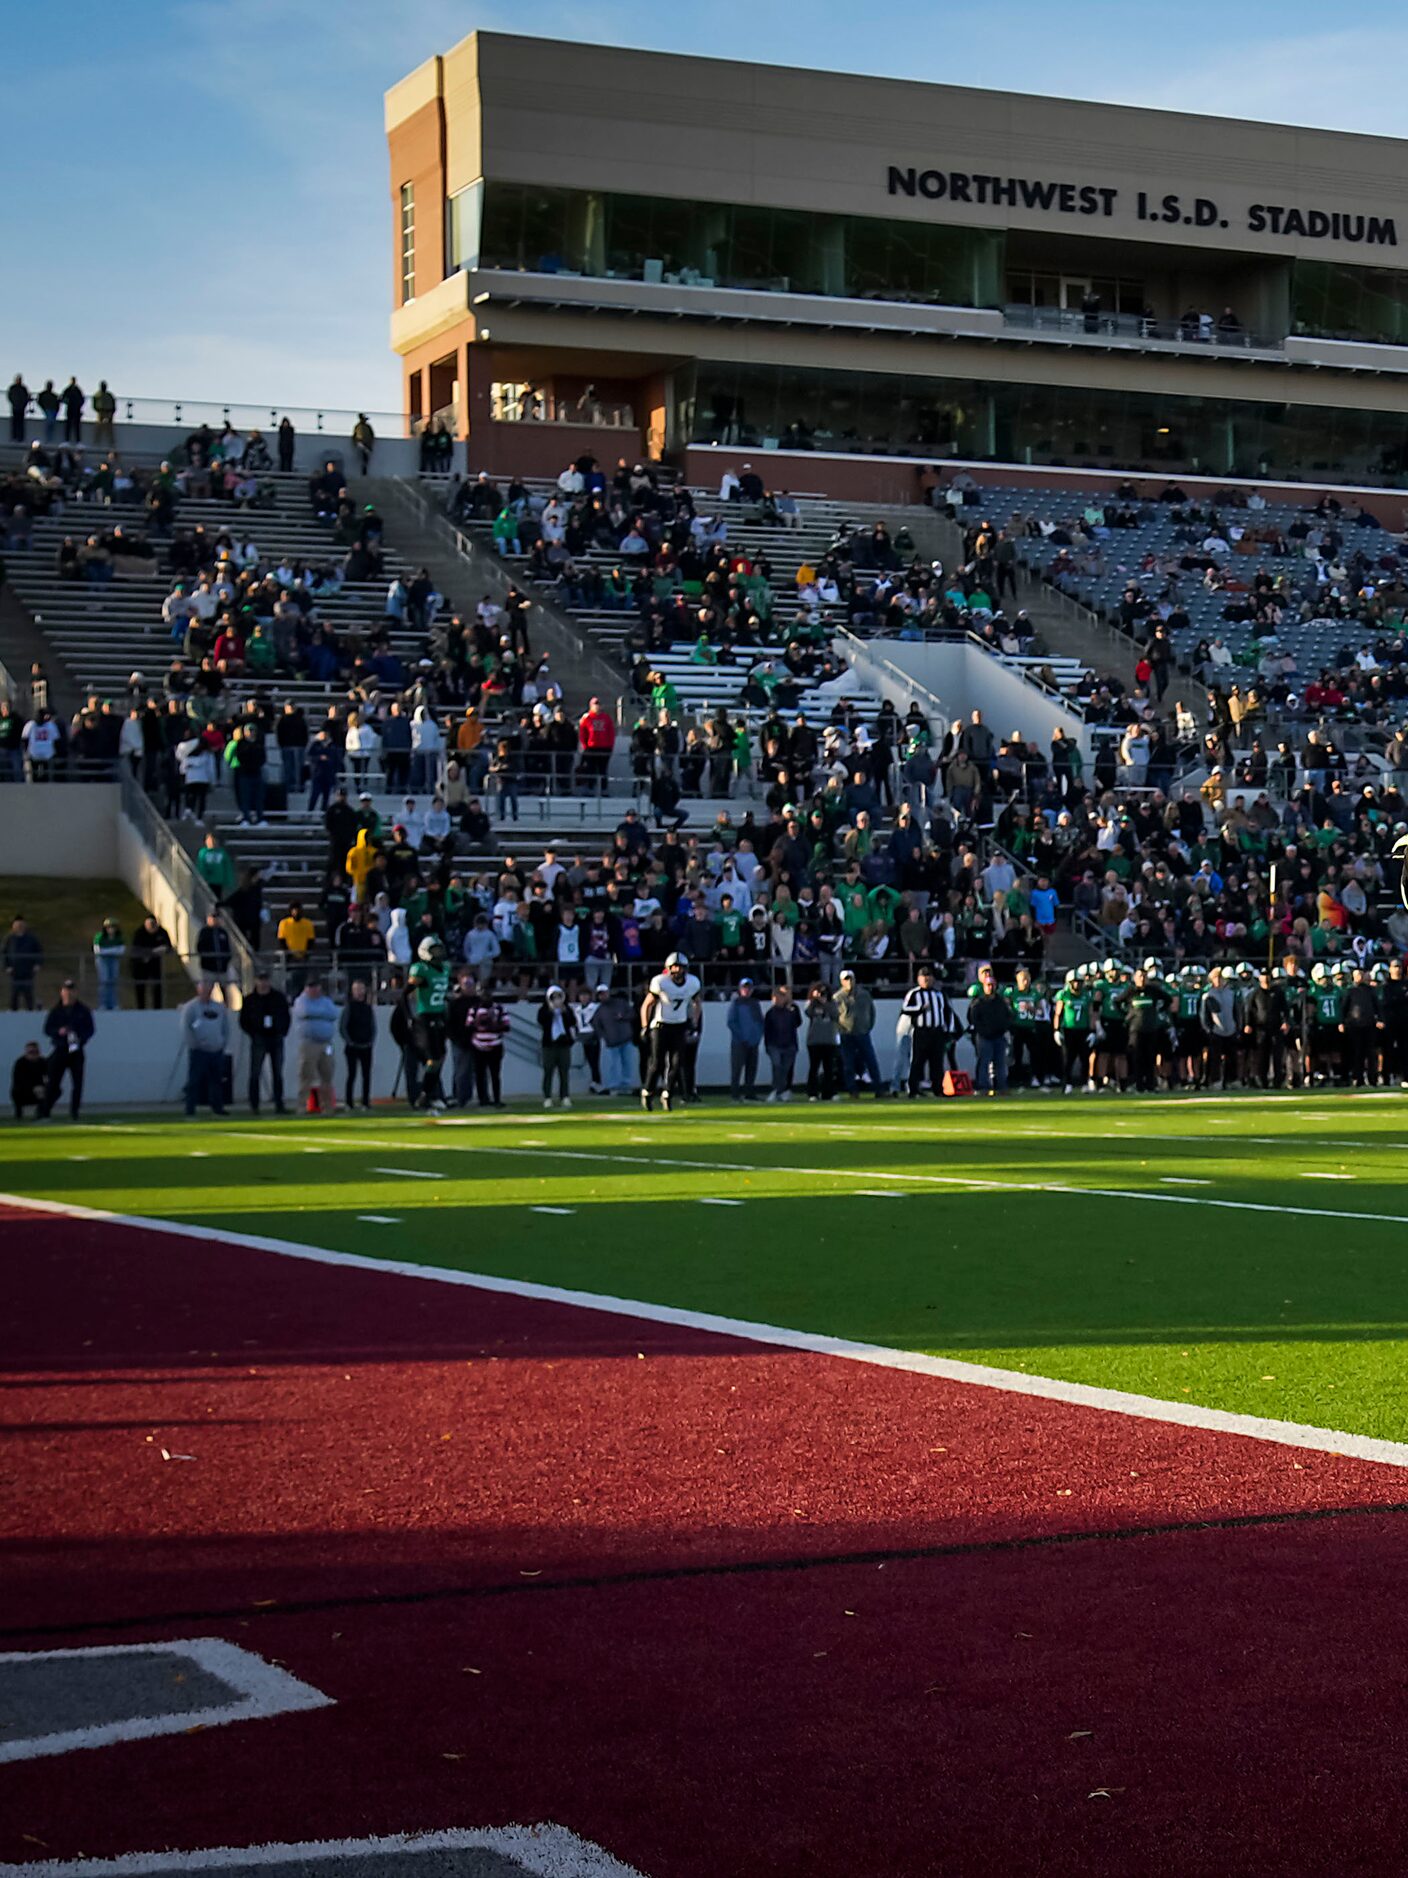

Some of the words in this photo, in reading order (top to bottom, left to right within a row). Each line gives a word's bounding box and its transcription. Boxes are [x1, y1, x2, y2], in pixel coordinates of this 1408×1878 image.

[888, 166, 1118, 216] NORTHWEST
[1137, 192, 1229, 228] I.S.D.
[1248, 204, 1397, 246] STADIUM
